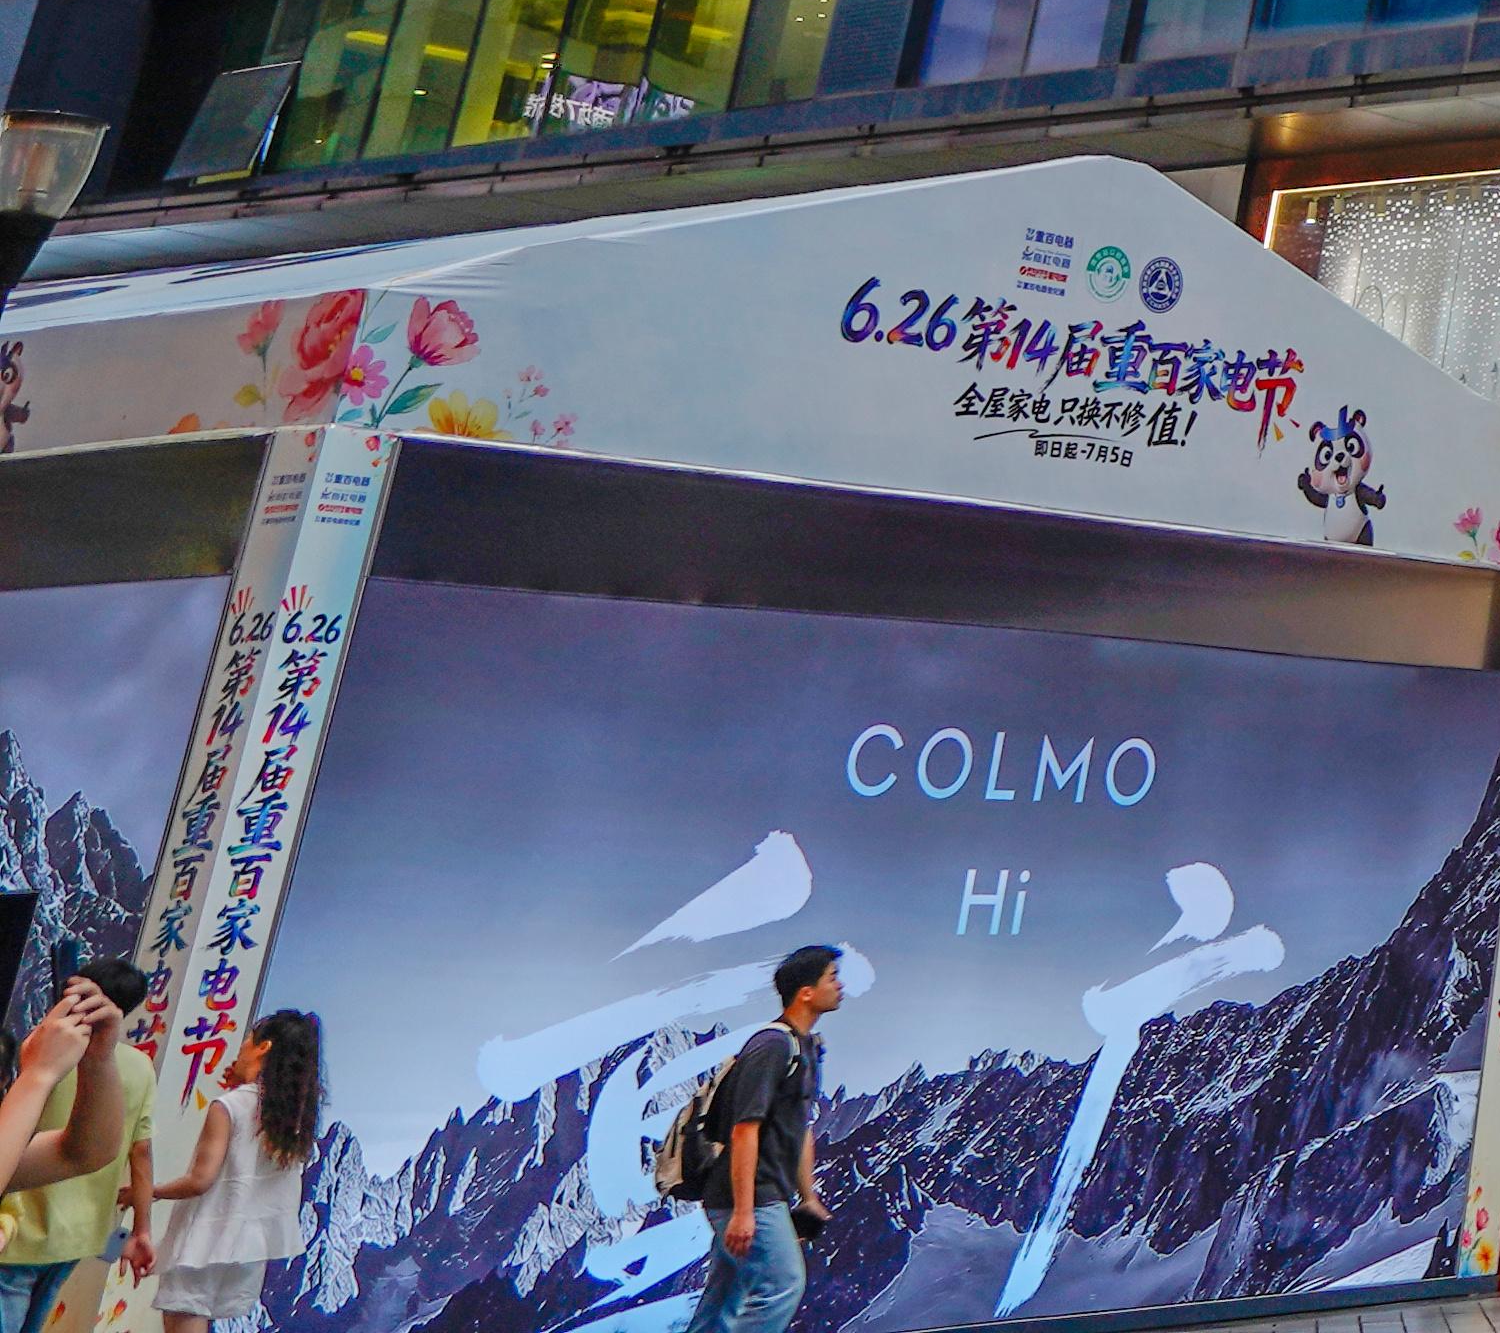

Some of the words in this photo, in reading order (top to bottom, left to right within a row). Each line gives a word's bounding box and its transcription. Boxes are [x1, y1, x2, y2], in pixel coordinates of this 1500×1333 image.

[1034, 439, 1134, 468] 即日起-7月5日
[847, 723, 1158, 807] COLMO
[956, 868, 1029, 937] Hi
